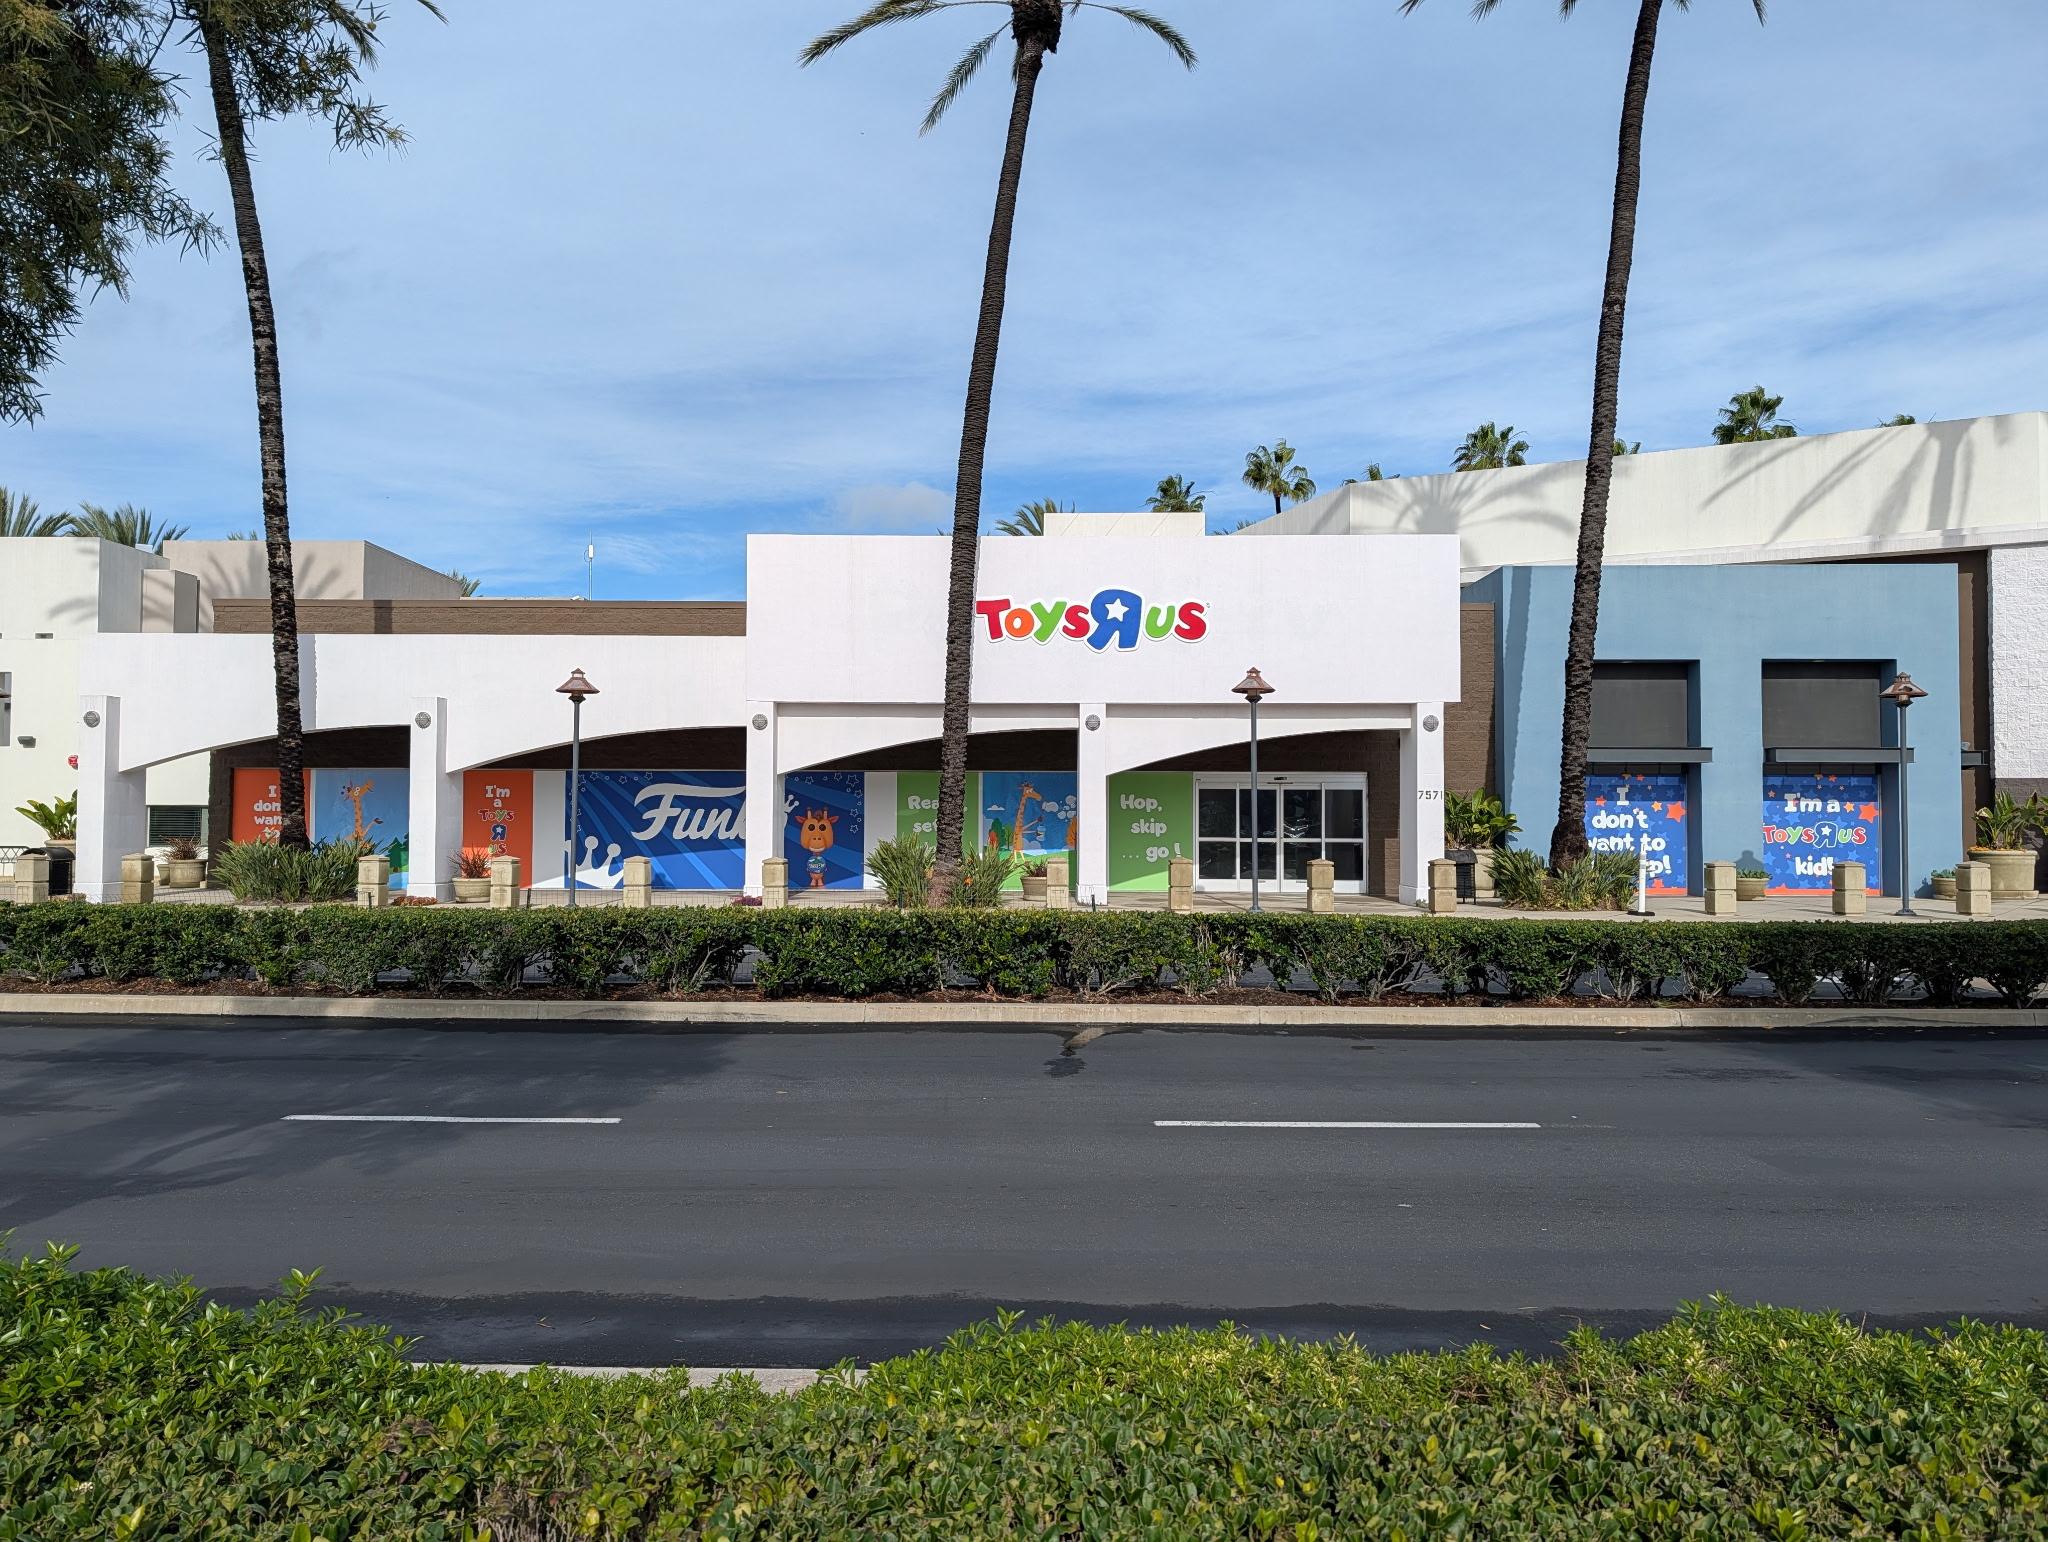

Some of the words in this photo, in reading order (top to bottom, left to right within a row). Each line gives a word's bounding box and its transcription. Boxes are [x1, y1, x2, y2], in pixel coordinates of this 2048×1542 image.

[268, 785, 277, 797] I
[485, 784, 510, 798] I'm
[1417, 790, 1443, 801] 7571
[1616, 786, 1630, 806] I
[253, 799, 281, 812] don
[493, 798, 503, 808] a
[630, 782, 787, 841] Fun
[1120, 794, 1163, 813] Hop,
[1784, 792, 1823, 813] I'm
[1826, 799, 1841, 813] a
[254, 816, 282, 825] wan
[1130, 817, 1168, 838] skip
[1591, 807, 1649, 829] don't
[1640, 832, 1667, 851] to
